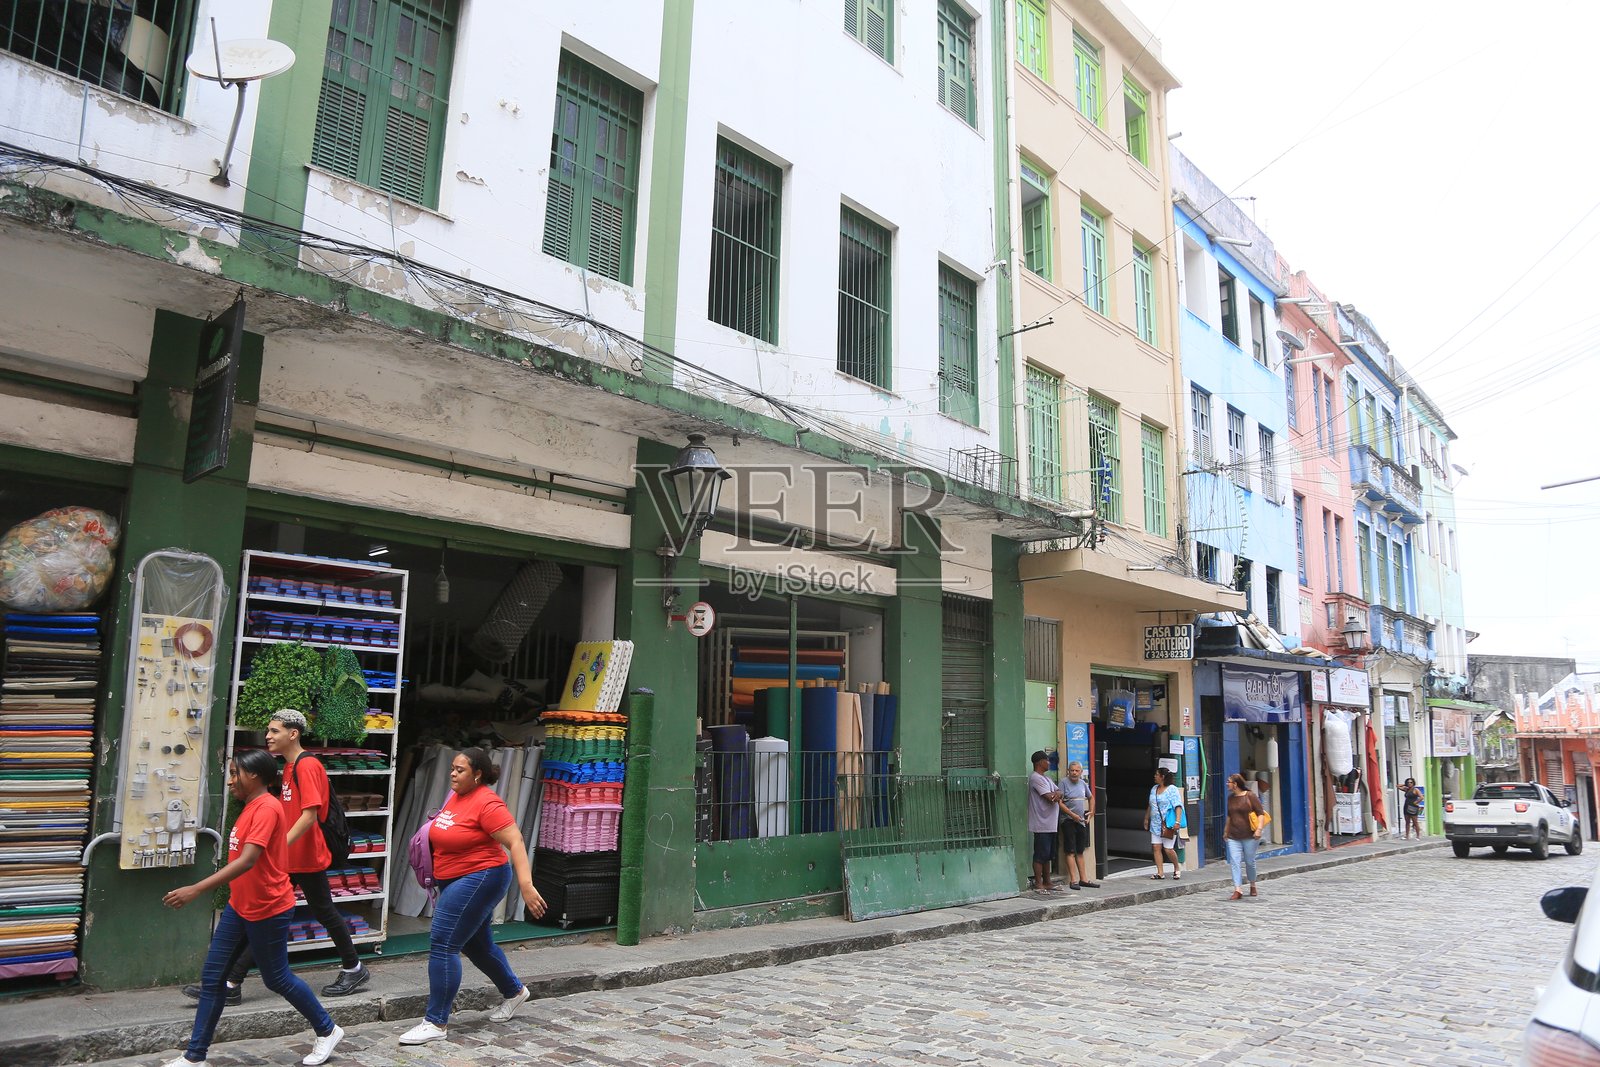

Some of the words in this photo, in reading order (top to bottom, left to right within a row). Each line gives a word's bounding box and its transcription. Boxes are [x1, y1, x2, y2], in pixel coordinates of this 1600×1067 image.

[1145, 627, 1171, 638] CASA
[1174, 626, 1188, 637] DO
[1144, 636, 1191, 651] SAPATEIRO
